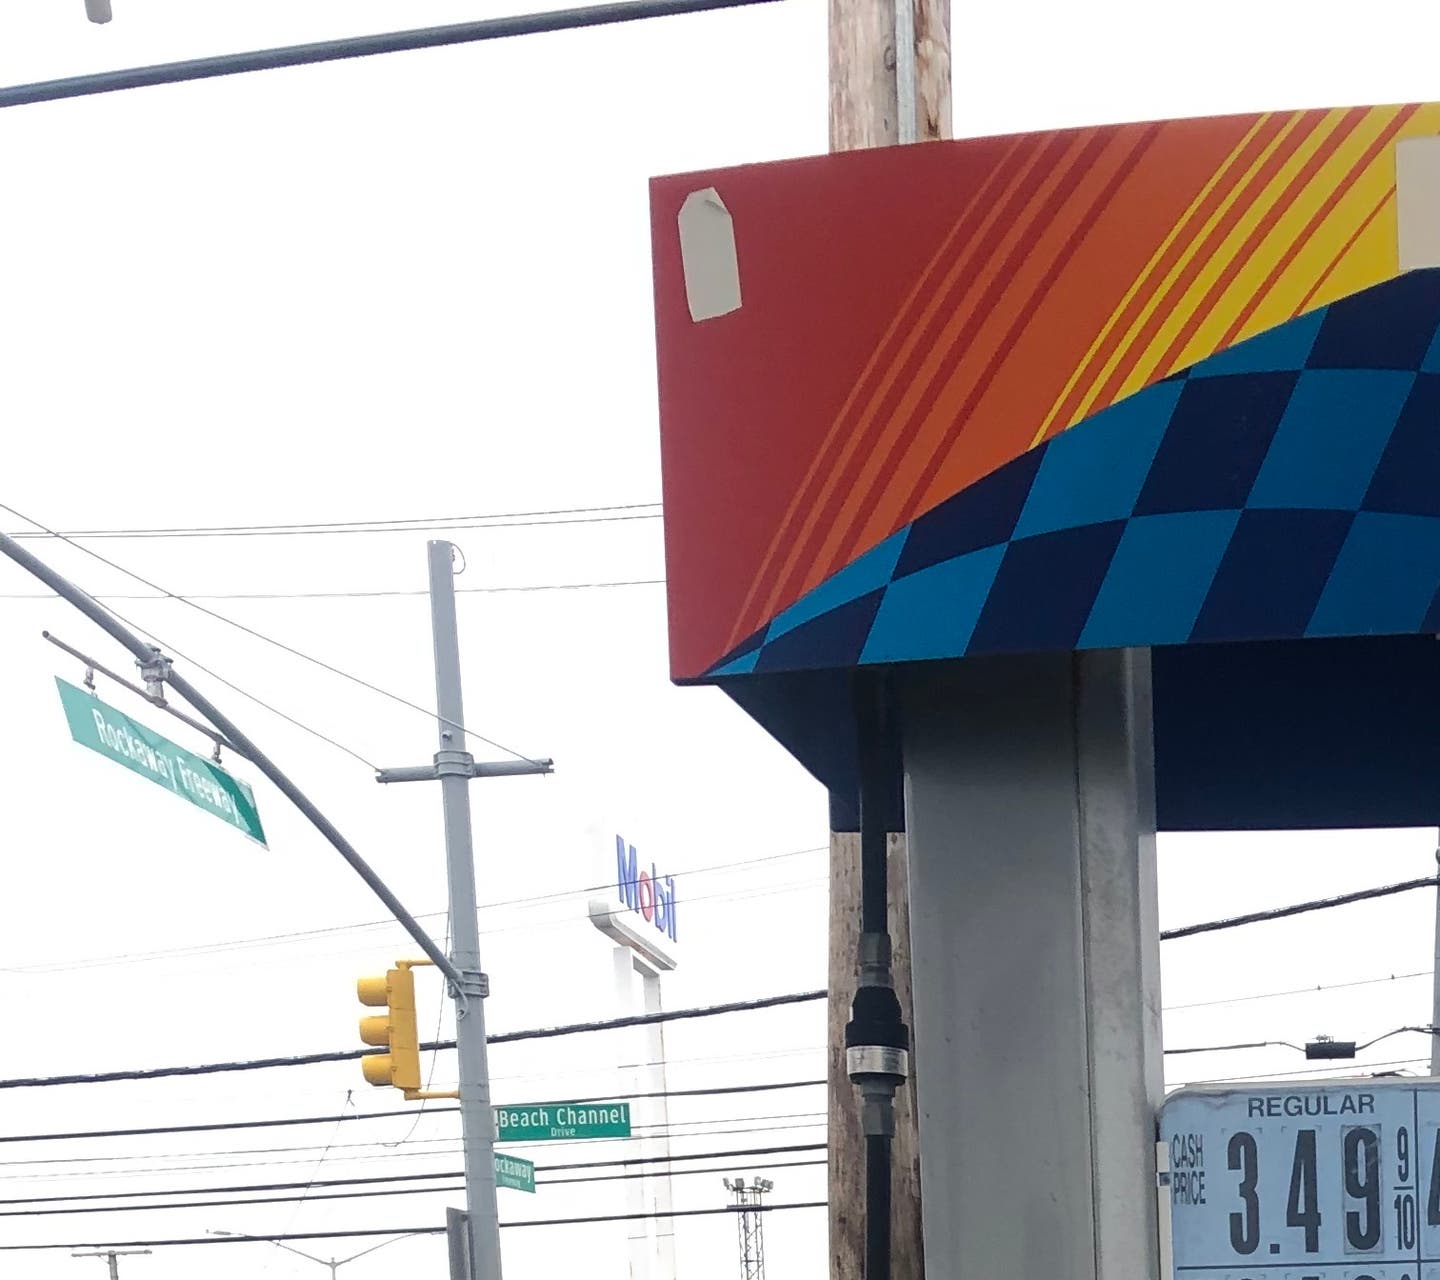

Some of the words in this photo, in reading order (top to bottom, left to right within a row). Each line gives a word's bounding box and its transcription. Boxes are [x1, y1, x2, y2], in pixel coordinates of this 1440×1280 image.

[92, 708, 178, 790] Rockaway
[176, 756, 240, 825] Freeway
[616, 834, 677, 943] Mobil
[499, 1108, 549, 1128] Beach
[556, 1105, 627, 1125] Channel
[1248, 1093, 1375, 1118] REGULAR
[551, 1127, 576, 1137] Drive
[1172, 1134, 1204, 1168] CASH
[495, 1158, 532, 1183] ockaway
[1173, 1171, 1206, 1205] PRICE
[1227, 1128, 1383, 1255] 3.49
